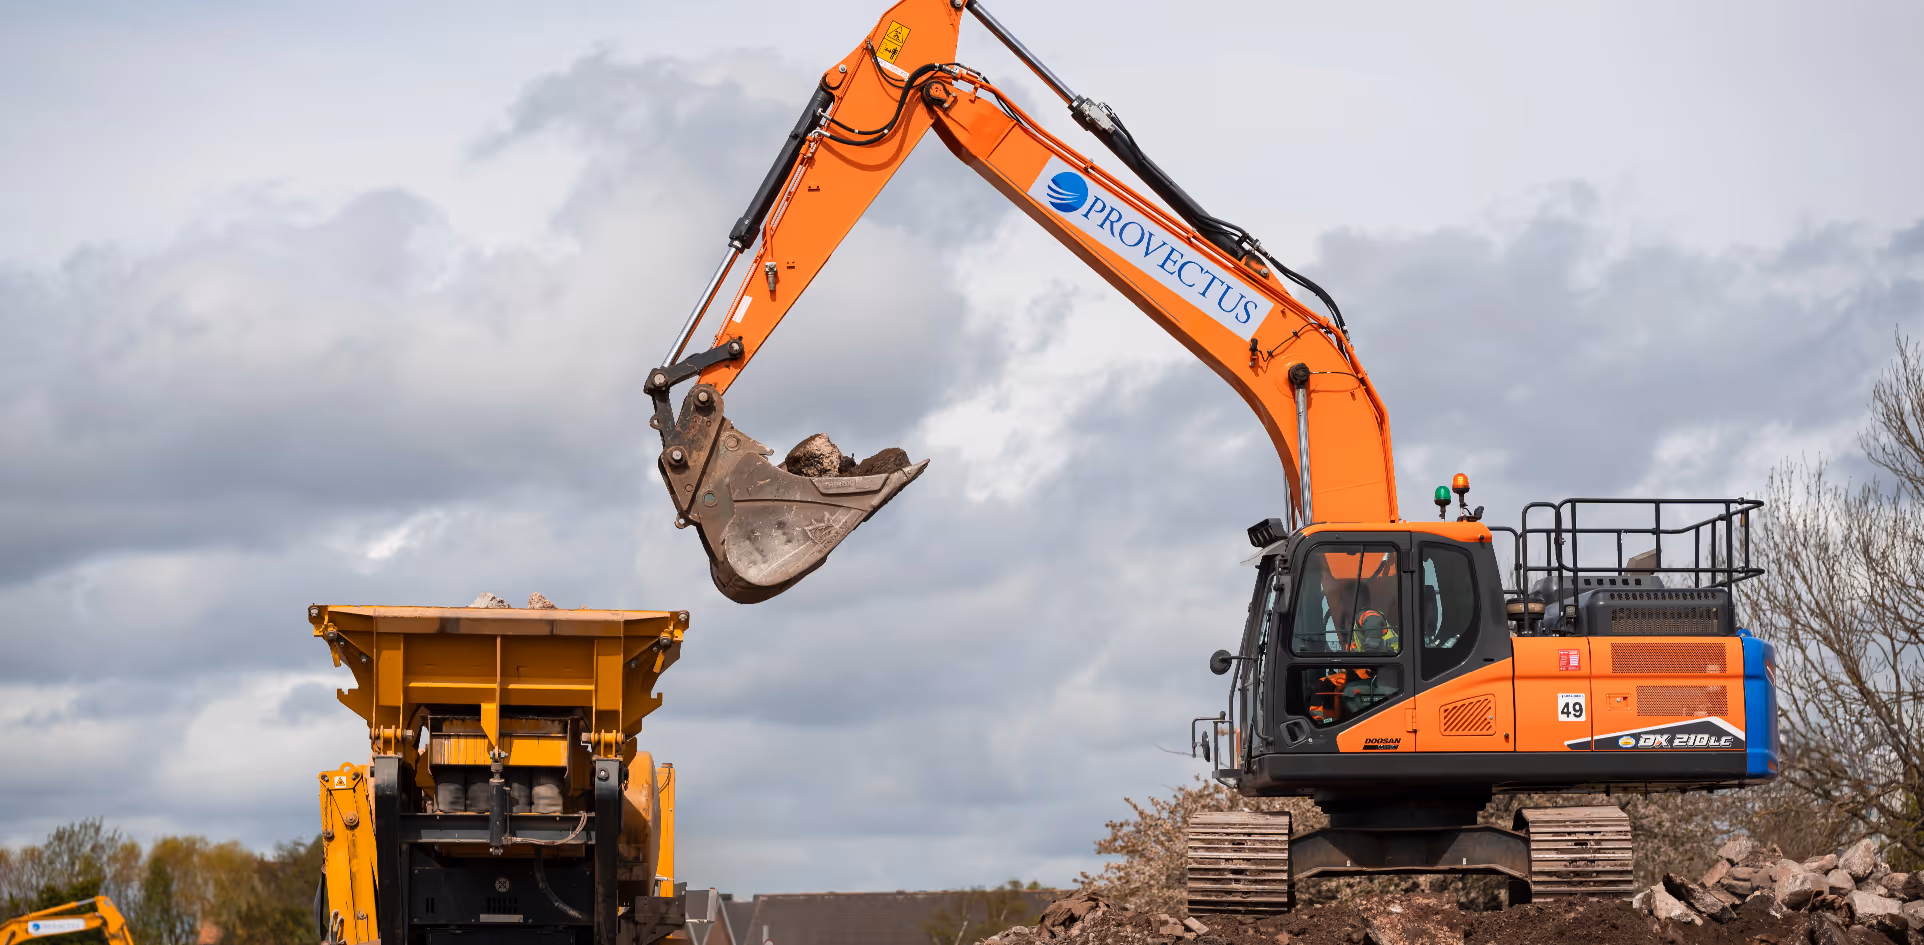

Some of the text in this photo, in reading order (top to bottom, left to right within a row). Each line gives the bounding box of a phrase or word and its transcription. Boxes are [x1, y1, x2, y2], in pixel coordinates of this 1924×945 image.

[1081, 195, 1258, 324] PROVECTUS
[1560, 701, 1584, 719] 49
[1638, 733, 1671, 748] DX
